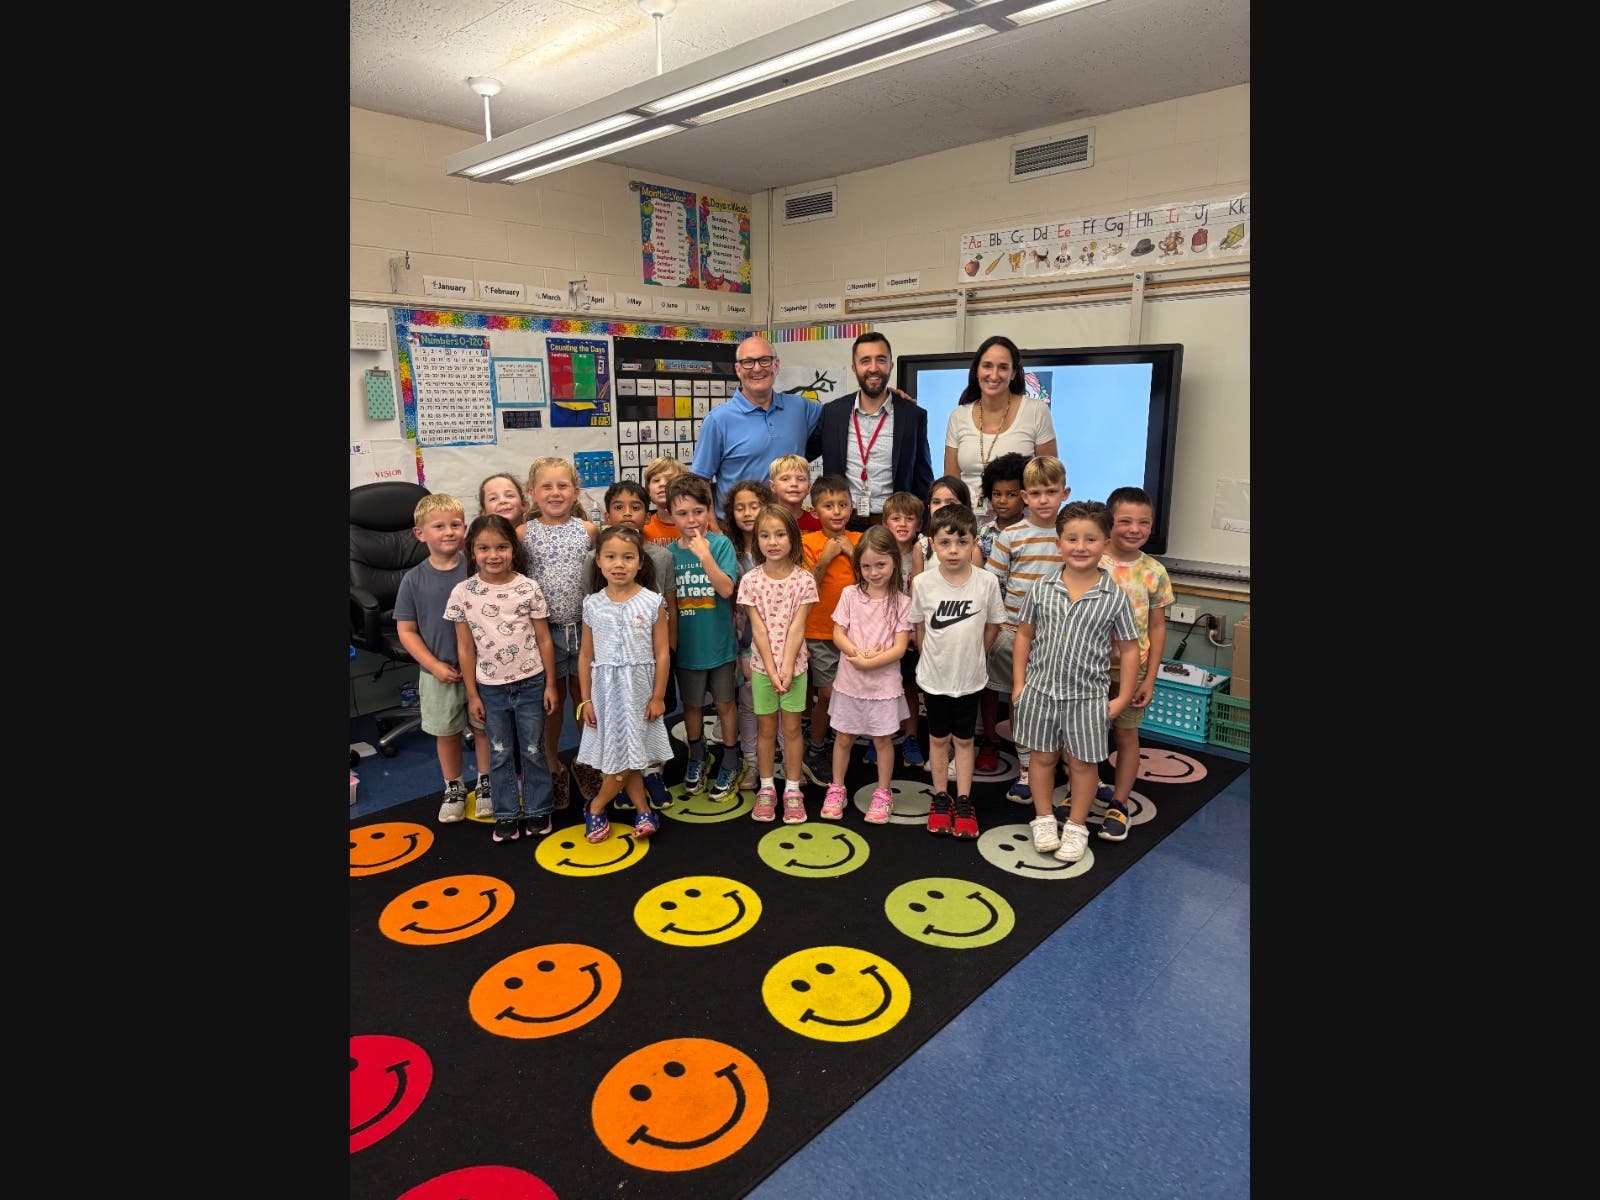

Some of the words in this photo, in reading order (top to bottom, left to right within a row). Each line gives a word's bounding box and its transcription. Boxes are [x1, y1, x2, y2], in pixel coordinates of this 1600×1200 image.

[968, 236, 982, 249] Aa
[989, 233, 1002, 247] Bb
[1011, 230, 1024, 244] Cc
[1033, 226, 1048, 241] Dd
[1057, 224, 1071, 238] Ee
[1083, 219, 1097, 235] Ff
[1104, 217, 1124, 236] Gg
[1136, 212, 1153, 228] Hh
[1165, 208, 1180, 224] Ii
[1195, 204, 1209, 226] Jj
[1229, 199, 1246, 216] Kk
[851, 281, 877, 290] November
[890, 277, 918, 286] December
[438, 282, 467, 293] January
[490, 286, 520, 297] February
[541, 293, 561, 301] March
[591, 296, 605, 305] April
[630, 298, 642, 306] May
[666, 301, 678, 309] June
[700, 304, 711, 312] July
[783, 304, 807, 313] September
[818, 302, 836, 310] October
[422, 336, 459, 345] Numbers
[459, 337, 483, 347] 0-120
[550, 343, 578, 353] Counting
[579, 344, 589, 352] the
[591, 345, 606, 354] Days
[598, 361, 604, 372] 5
[699, 402, 704, 413] 3
[626, 427, 632, 438] 6
[663, 425, 669, 436] 8
[624, 450, 635, 461] 13
[643, 449, 653, 459] 14
[663, 448, 671, 457] 15
[681, 447, 689, 457] 16
[688, 586, 715, 597] race
[936, 600, 973, 617] NIKE
